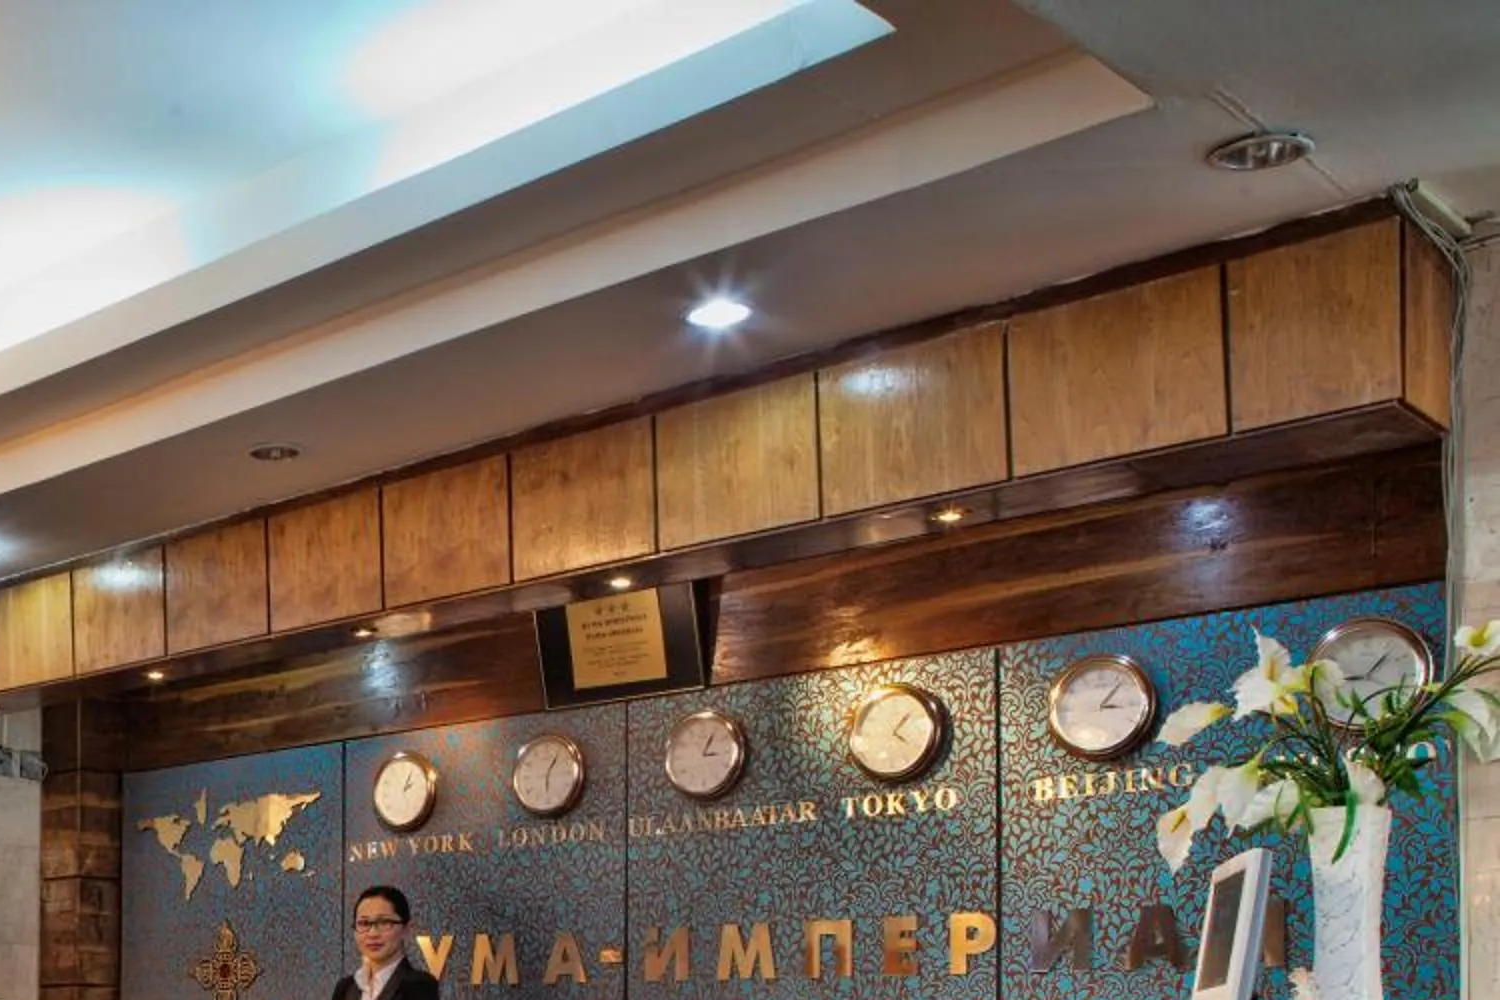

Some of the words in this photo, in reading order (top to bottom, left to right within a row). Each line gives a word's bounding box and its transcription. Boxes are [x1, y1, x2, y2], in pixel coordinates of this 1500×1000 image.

[1034, 763, 1193, 801] BEIJING
[628, 800, 817, 837] ULAANBAATAR
[843, 787, 958, 819] TOKYO
[350, 840, 399, 862] NEW
[408, 831, 475, 854] YORK
[499, 820, 606, 847] LONDON
[415, 900, 1287, 986] УМА-ИМПЕРИА
